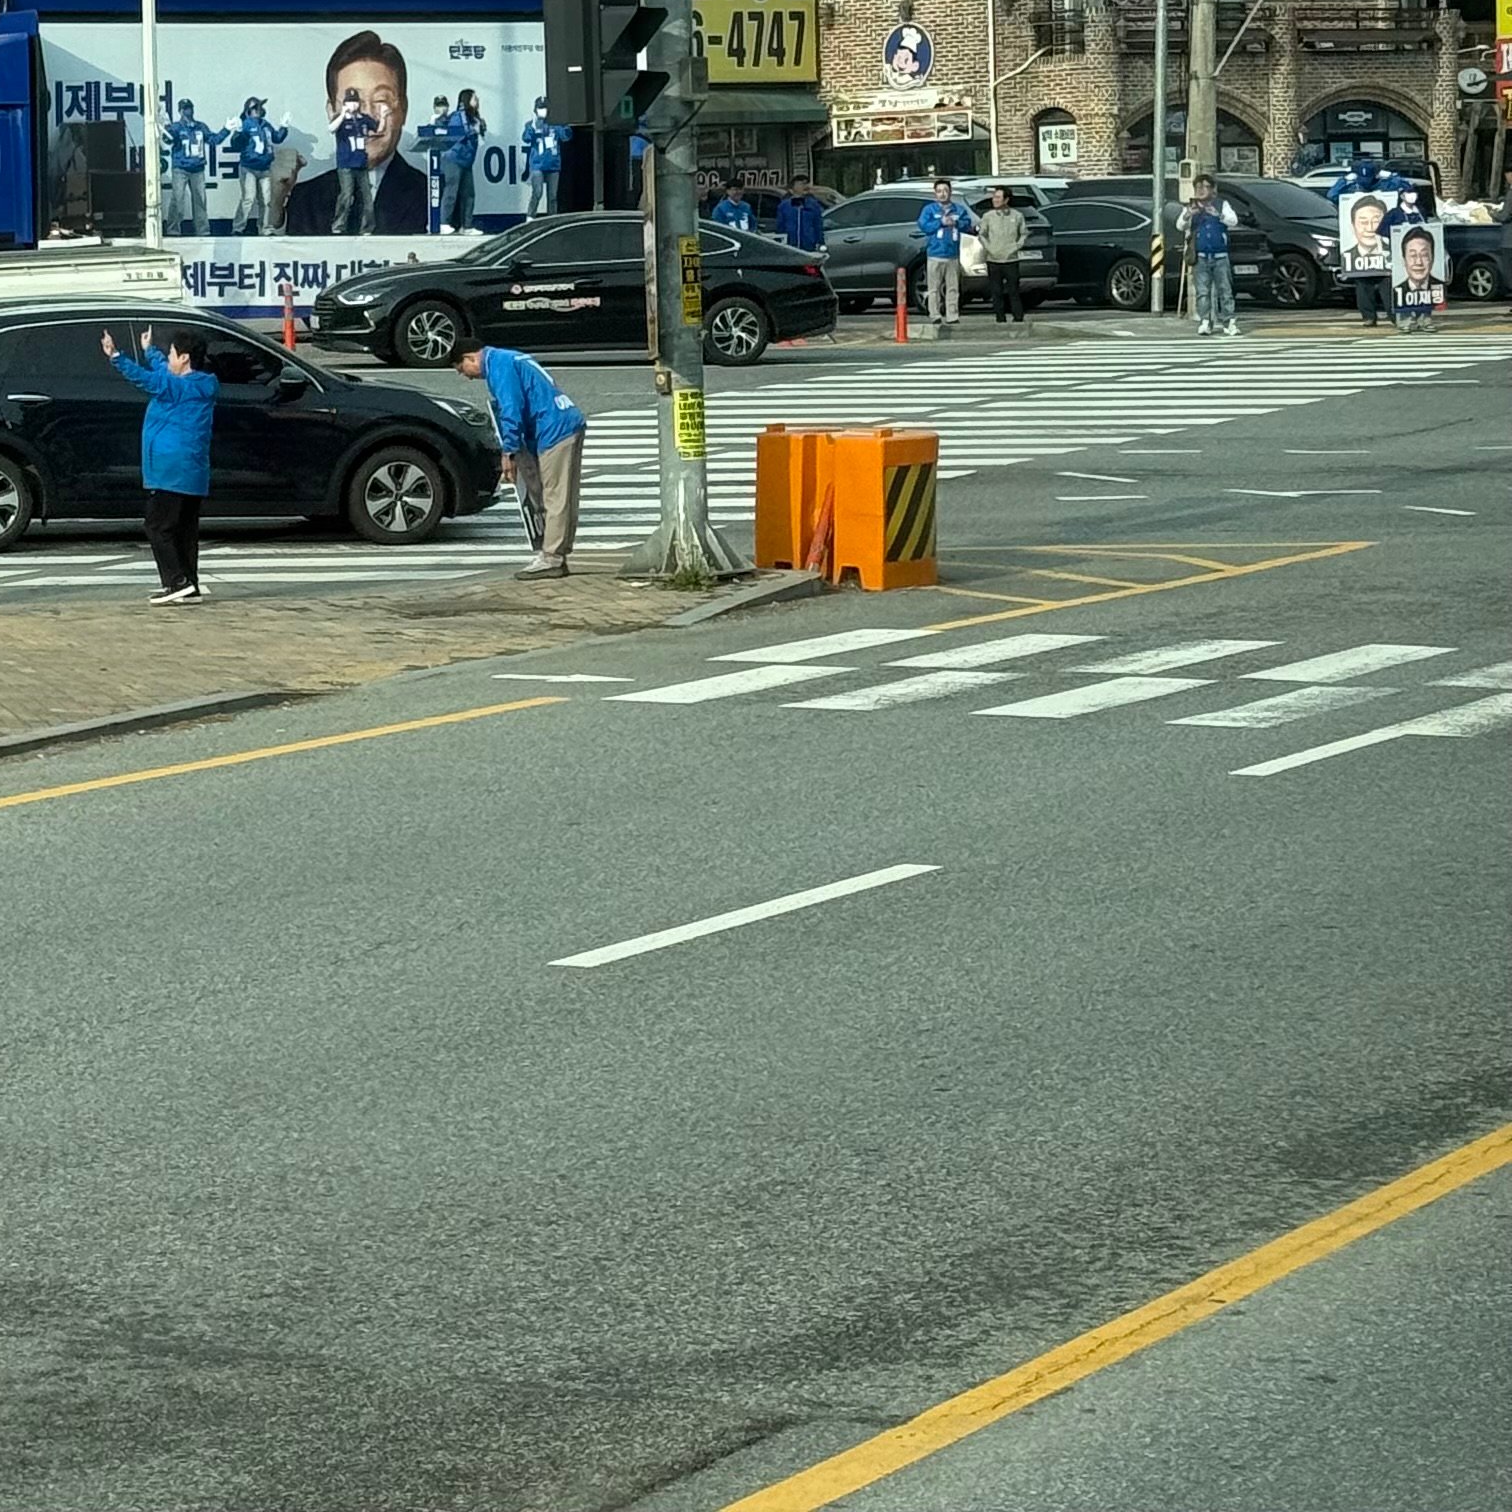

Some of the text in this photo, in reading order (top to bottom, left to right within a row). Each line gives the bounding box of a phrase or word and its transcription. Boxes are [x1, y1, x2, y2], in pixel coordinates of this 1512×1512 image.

[1344, 253, 1352, 272] 1
[273, 261, 330, 297] 진짜
[1395, 288, 1403, 307] 1
